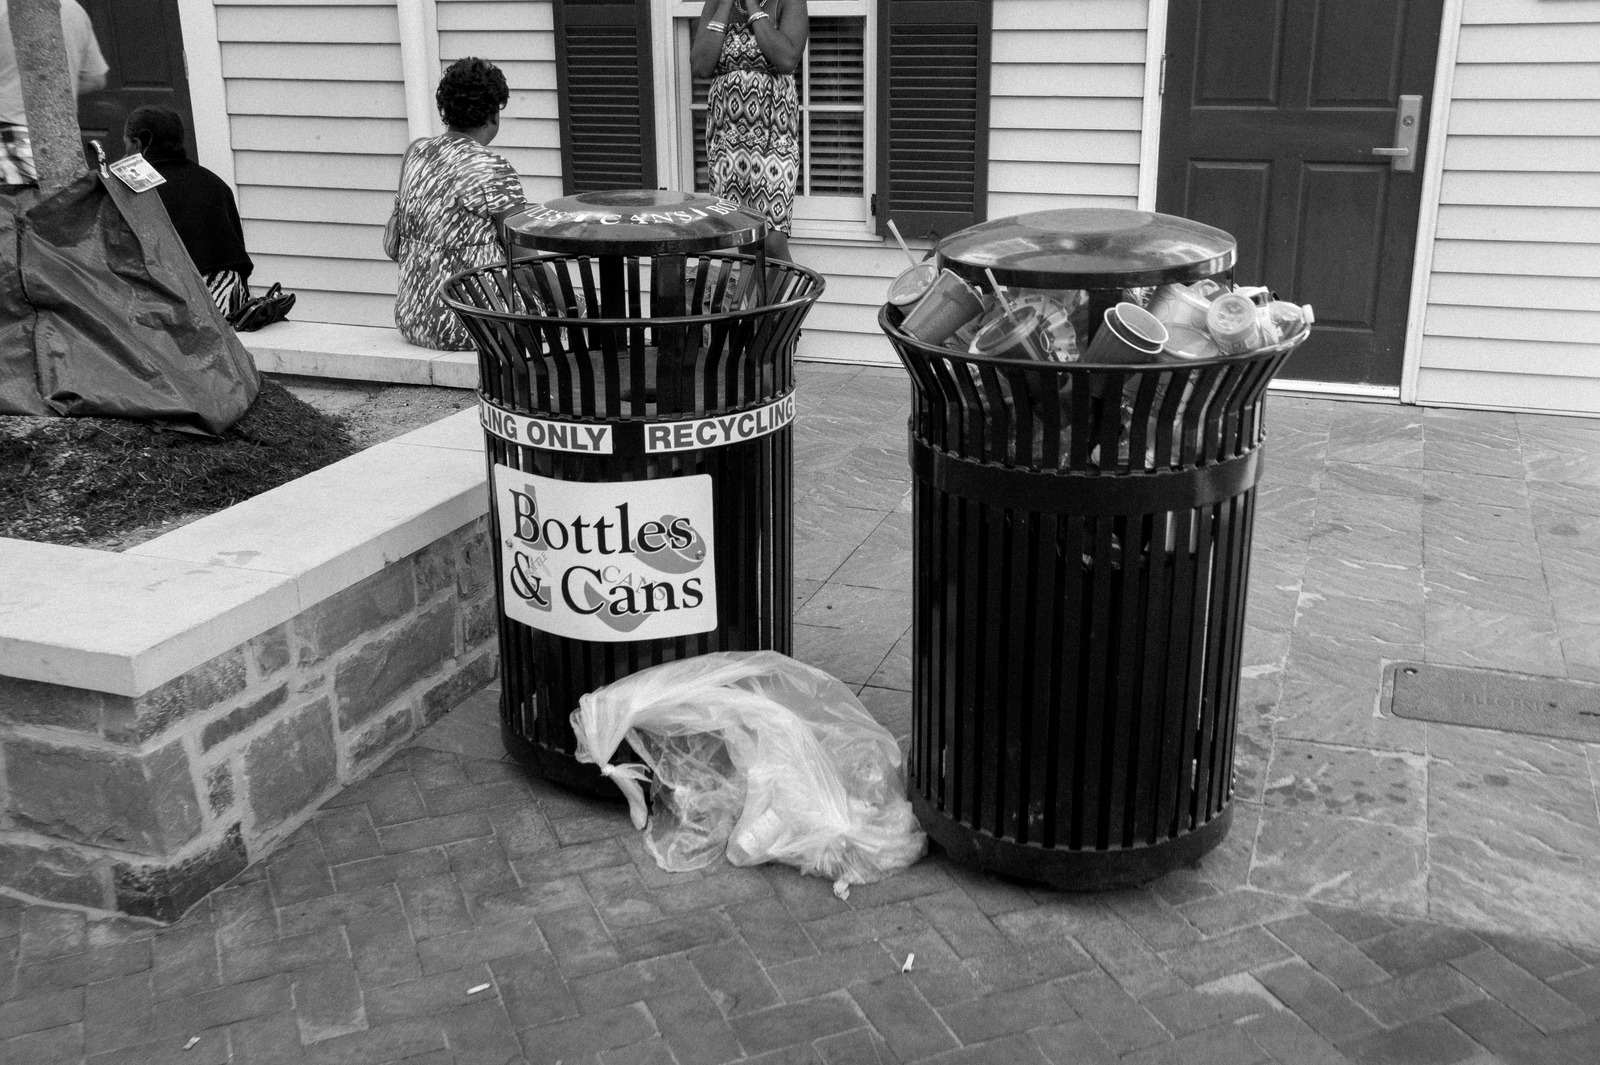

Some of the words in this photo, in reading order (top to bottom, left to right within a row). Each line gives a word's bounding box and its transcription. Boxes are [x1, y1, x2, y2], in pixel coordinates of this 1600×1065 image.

[600, 211, 692, 225] CANS
[480, 402, 517, 440] LING
[527, 420, 608, 451] ONLY
[648, 396, 793, 450] RECYCLING
[509, 488, 693, 554] Bottles
[510, 551, 548, 605] &
[561, 566, 703, 615] Cans
